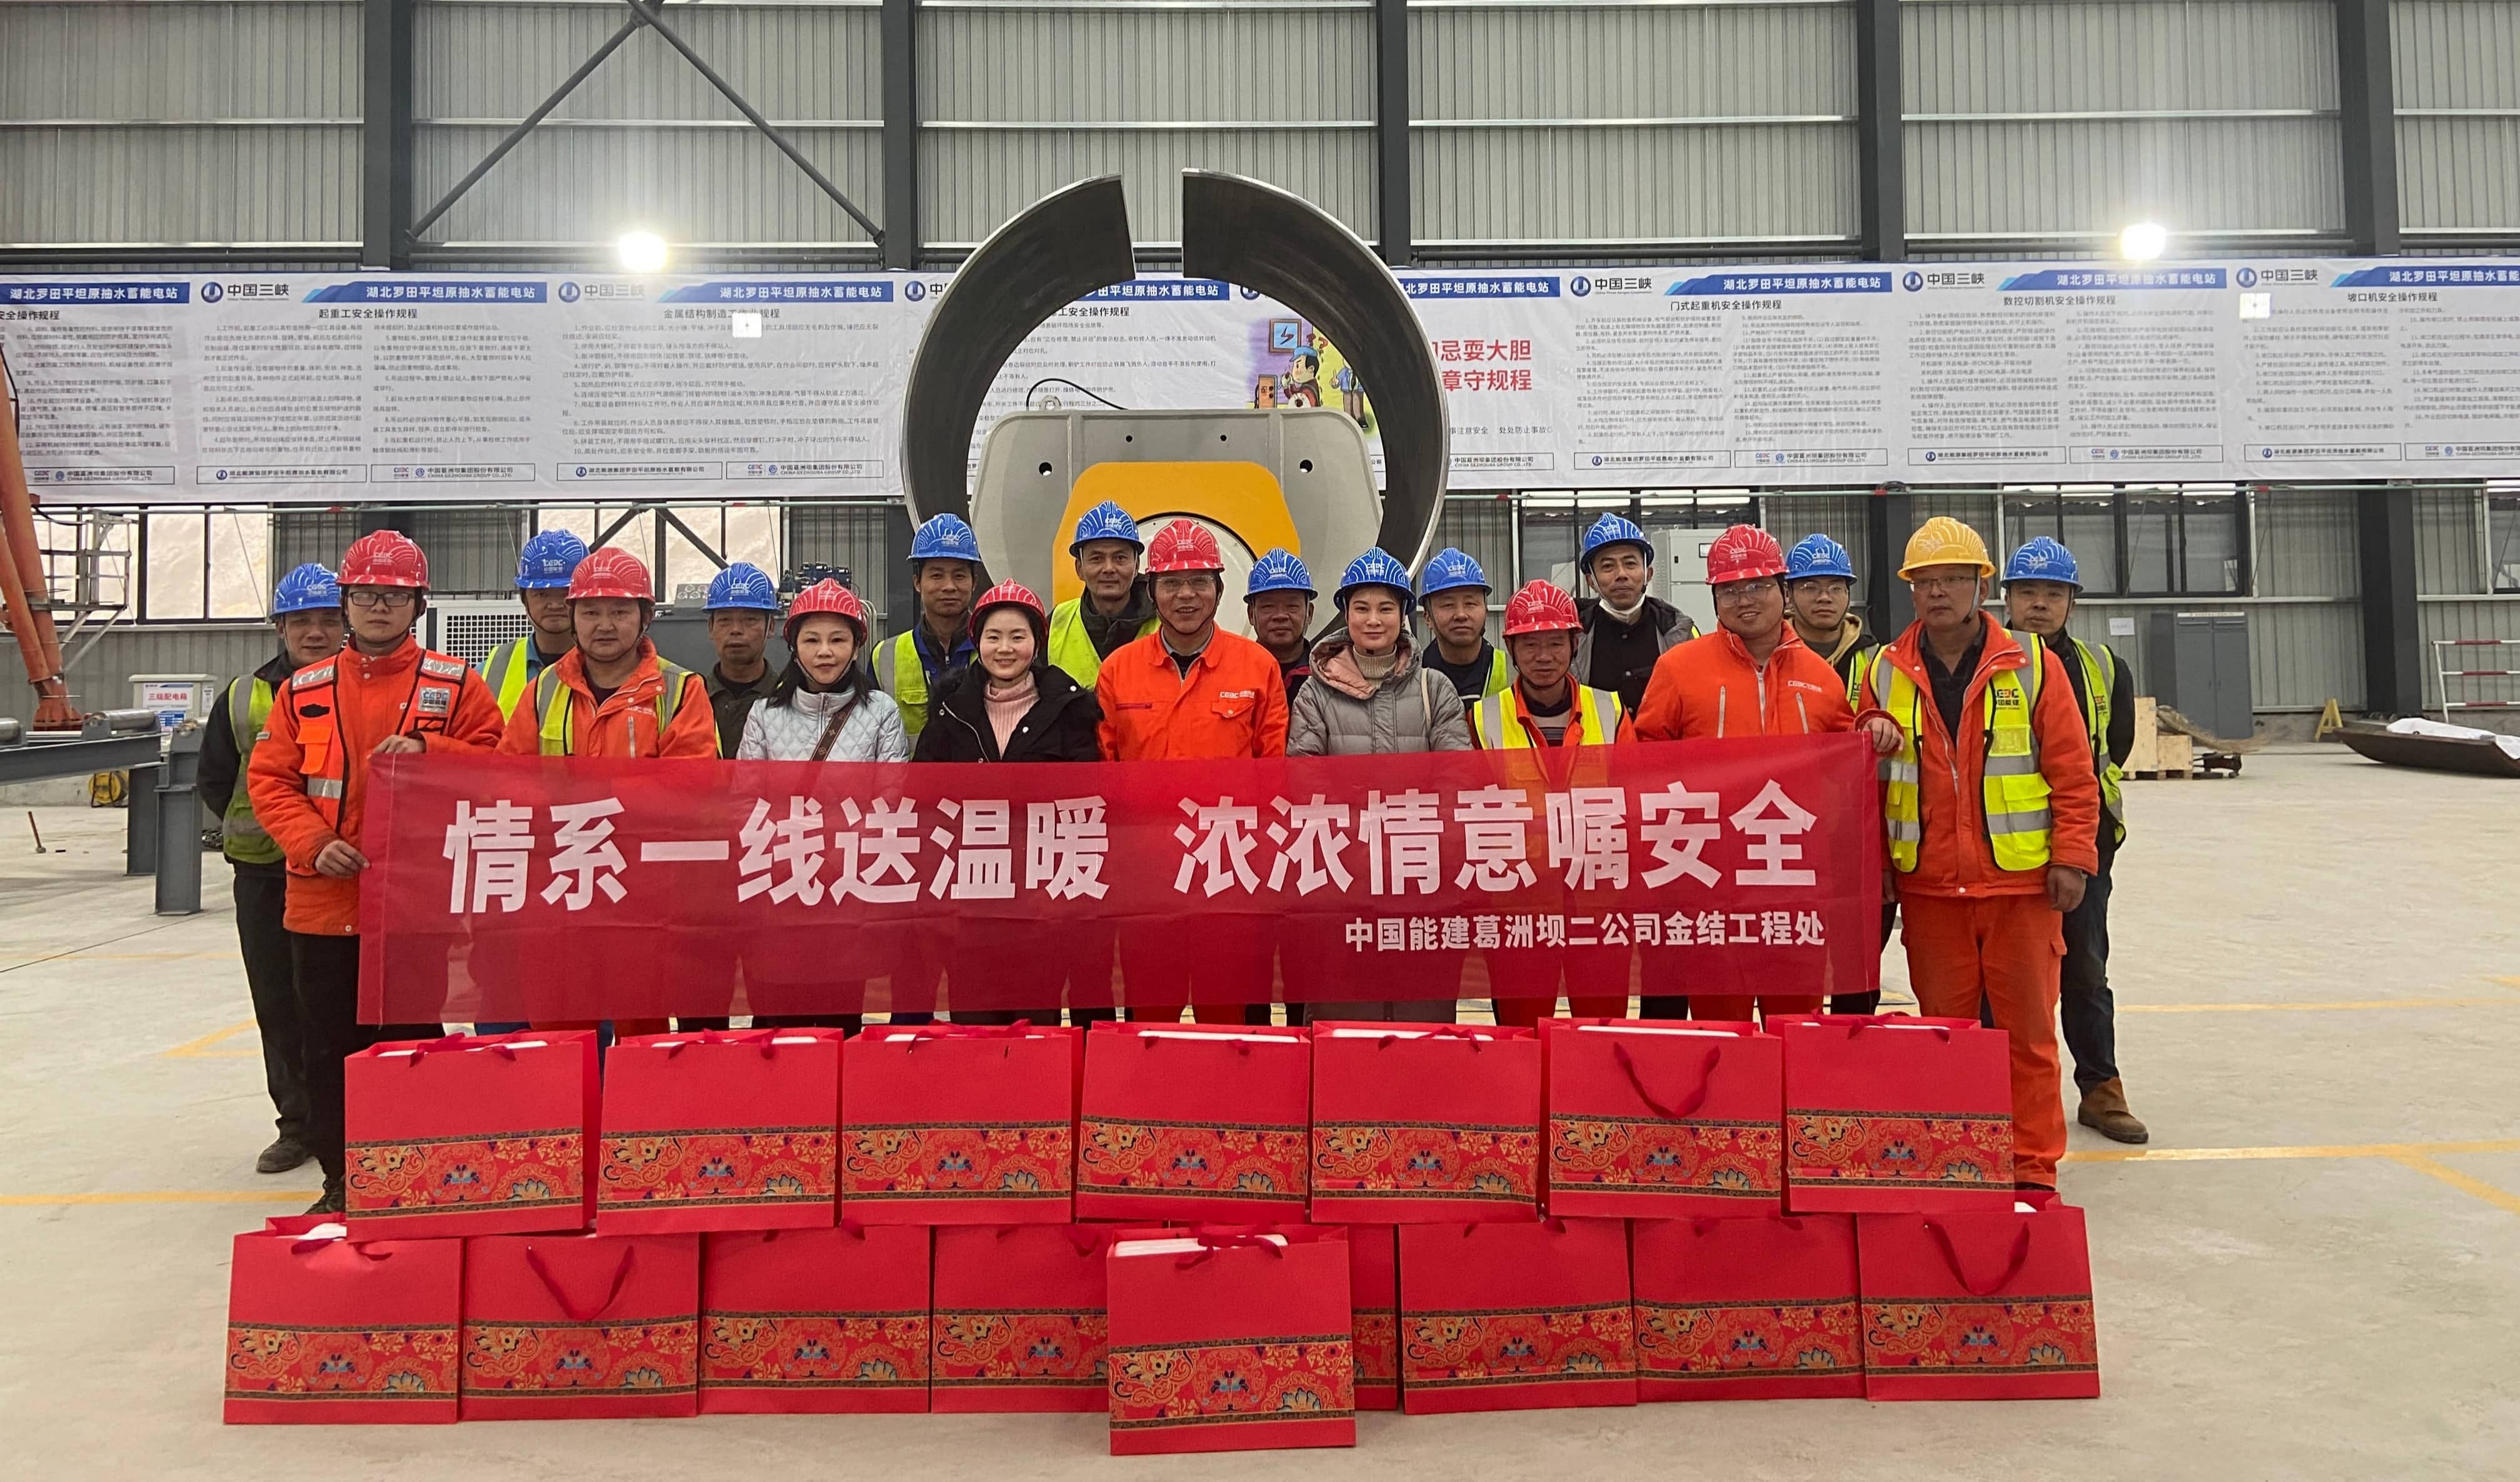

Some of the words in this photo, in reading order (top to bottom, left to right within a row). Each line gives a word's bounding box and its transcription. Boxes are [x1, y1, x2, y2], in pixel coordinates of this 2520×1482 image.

[1928, 273, 1984, 285] 中国三峡
[2057, 274, 2216, 285] 湖北罗田平坦原抽水蓄能电站
[2261, 269, 2318, 281] 中国三峡
[930, 283, 948, 296] 中
[1401, 282, 1549, 294] 北罗田平坦原抽水蓄能电站
[1595, 278, 1652, 290] 中国三峡
[1723, 277, 1881, 290] 湖北罗田平坦原抽水蓄能电站
[10, 288, 178, 299] 湖北罗田平坦原抽水蓄能电站
[228, 284, 289, 296] 中国三峡
[366, 286, 535, 299] 湖北罗田平坦原抽水蓄能电站
[585, 284, 644, 296] 中国三峡
[720, 286, 882, 298] 湖北罗田平坦原抽水蓄能电站
[1089, 285, 1218, 297] 田平坦原抽水蓄能电站
[2004, 296, 2116, 306] 数控切割机安全操作规程
[2348, 292, 2438, 303] 坡口机安全操作规程
[1051, 306, 1129, 317] 工安全操作规程
[1671, 300, 1782, 311] 门式起重机安全操作规程
[319, 309, 418, 319] 起重工安全操作规程
[664, 309, 780, 319] 金属结构制造工规程
[1442, 369, 1532, 392] 章守规程
[149, 693, 188, 701] 三级配电箱
[442, 795, 1110, 914] 情系一线送温暖
[1173, 779, 1817, 898] 浓浓情意嘱安全
[1346, 911, 1826, 952] 中国能建葛洲坝二公司金结工程处
